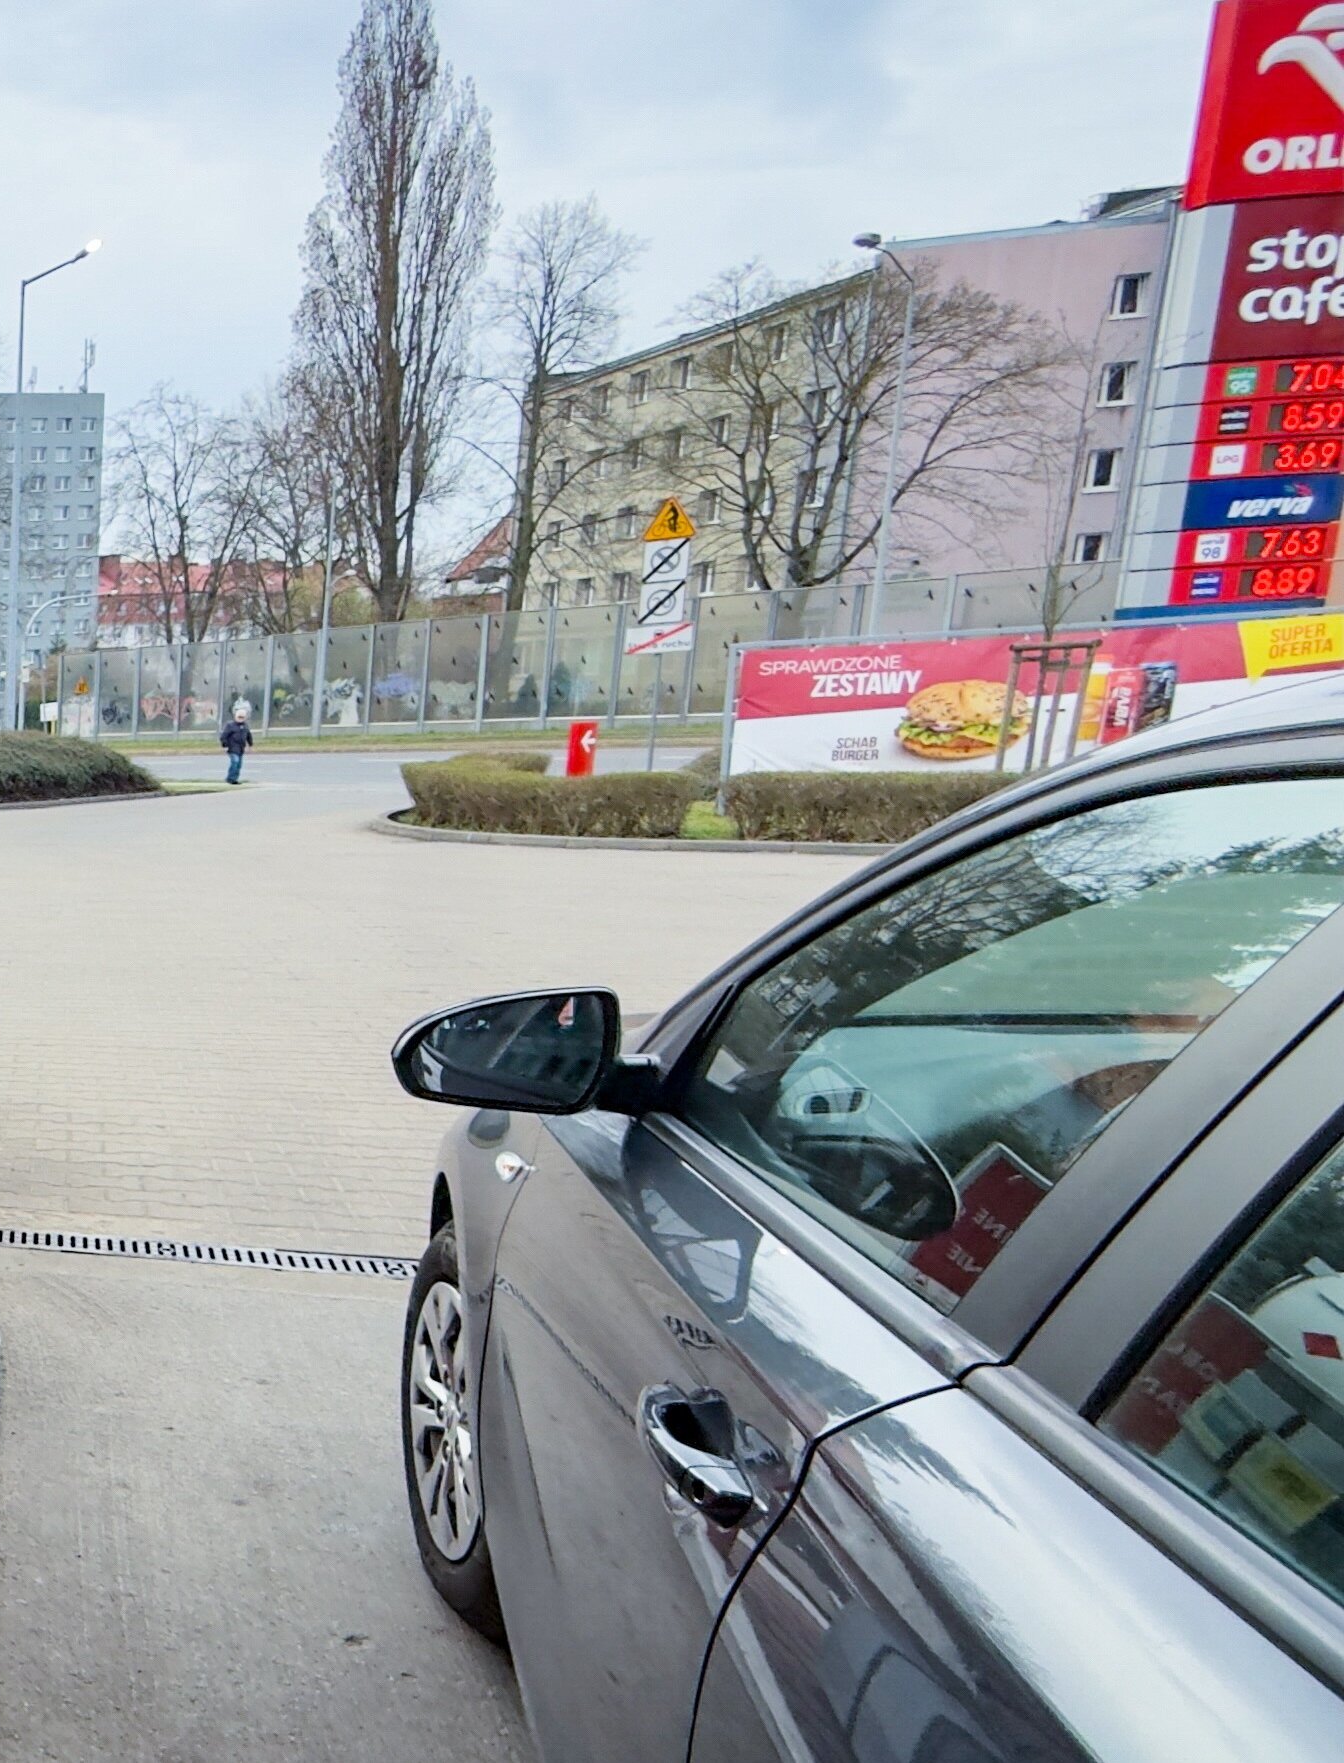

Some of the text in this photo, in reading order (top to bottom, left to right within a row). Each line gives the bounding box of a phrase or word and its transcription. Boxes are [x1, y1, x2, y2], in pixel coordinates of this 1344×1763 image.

[1243, 134, 1344, 175] ORL
[1230, 379, 1250, 395] 95
[1283, 402, 1344, 432] 8.59
[1274, 442, 1337, 468] 3.69
[1226, 495, 1315, 519] verva
[1201, 546, 1222, 559] 98
[1260, 529, 1322, 558] 7.63
[1252, 568, 1316, 596] 8.89
[1269, 623, 1327, 643] SUPER
[1269, 638, 1334, 660] OFERTA
[758, 655, 903, 676] SPRAWDZONE
[810, 670, 923, 698] ZESTAWY
[836, 736, 878, 749] SCHAB
[831, 749, 880, 761] BURGER
